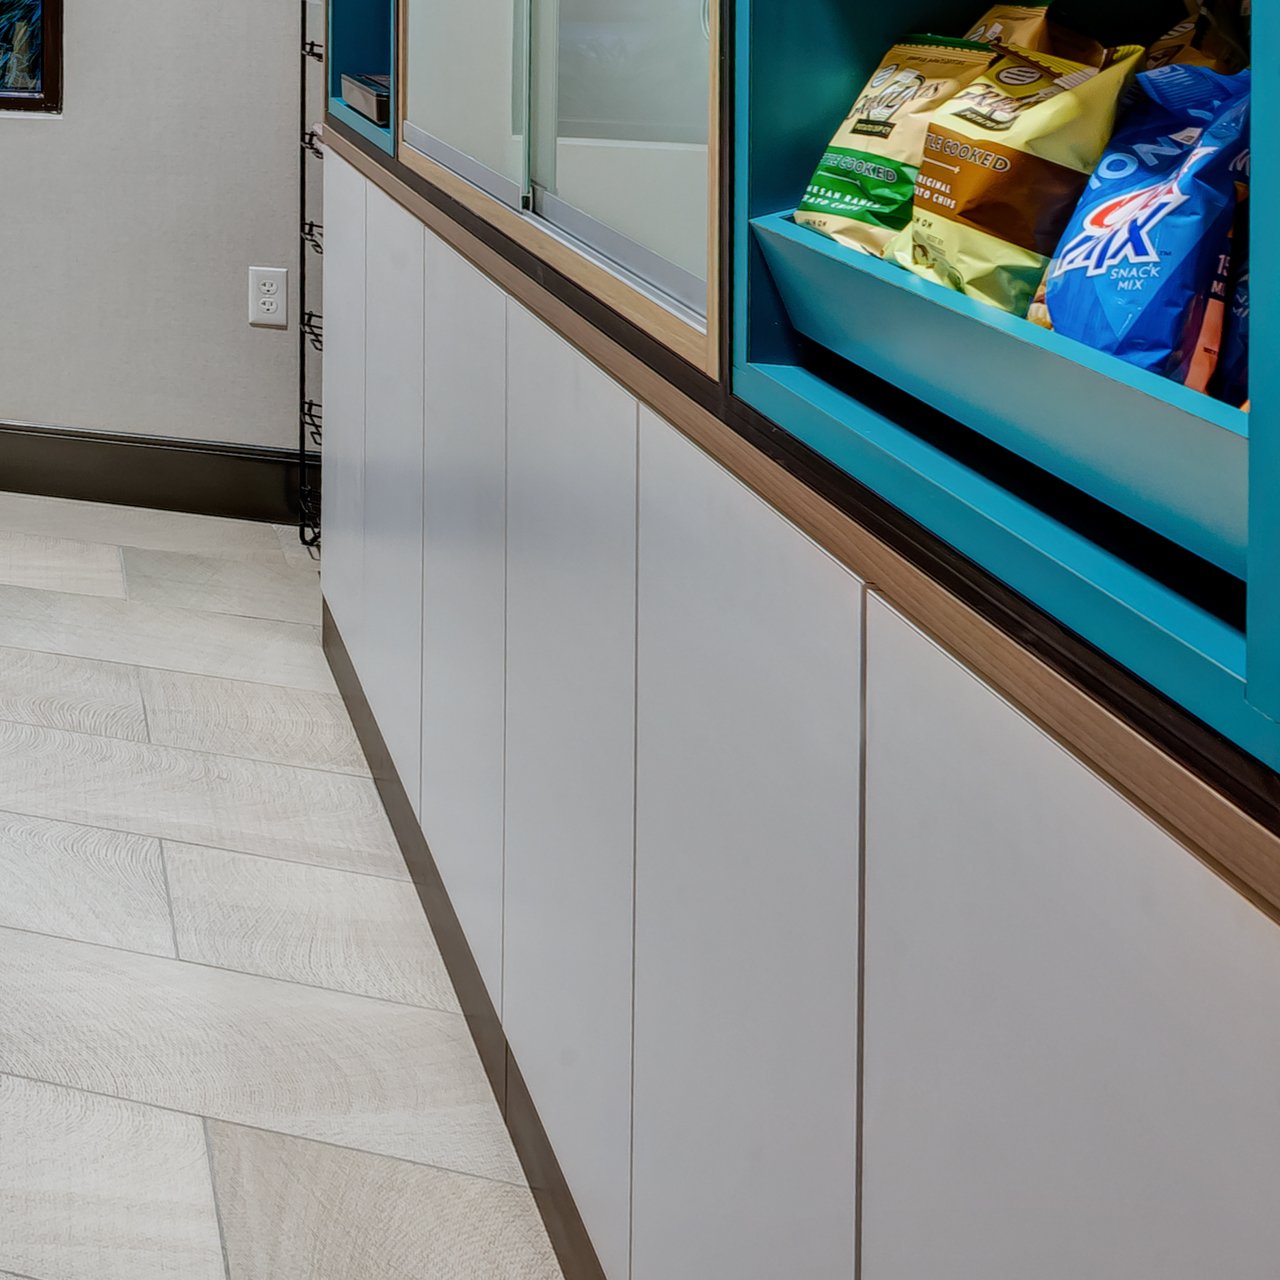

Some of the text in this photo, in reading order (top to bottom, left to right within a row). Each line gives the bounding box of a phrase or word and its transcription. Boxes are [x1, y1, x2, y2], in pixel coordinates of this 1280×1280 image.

[943, 139, 1012, 173] COOKED
[838, 154, 898, 183] COOKED
[917, 175, 952, 195] RIGINAL
[932, 193, 958, 210] CHIPS
[1109, 263, 1161, 280] SNACK
[1117, 279, 1144, 291] MIX
